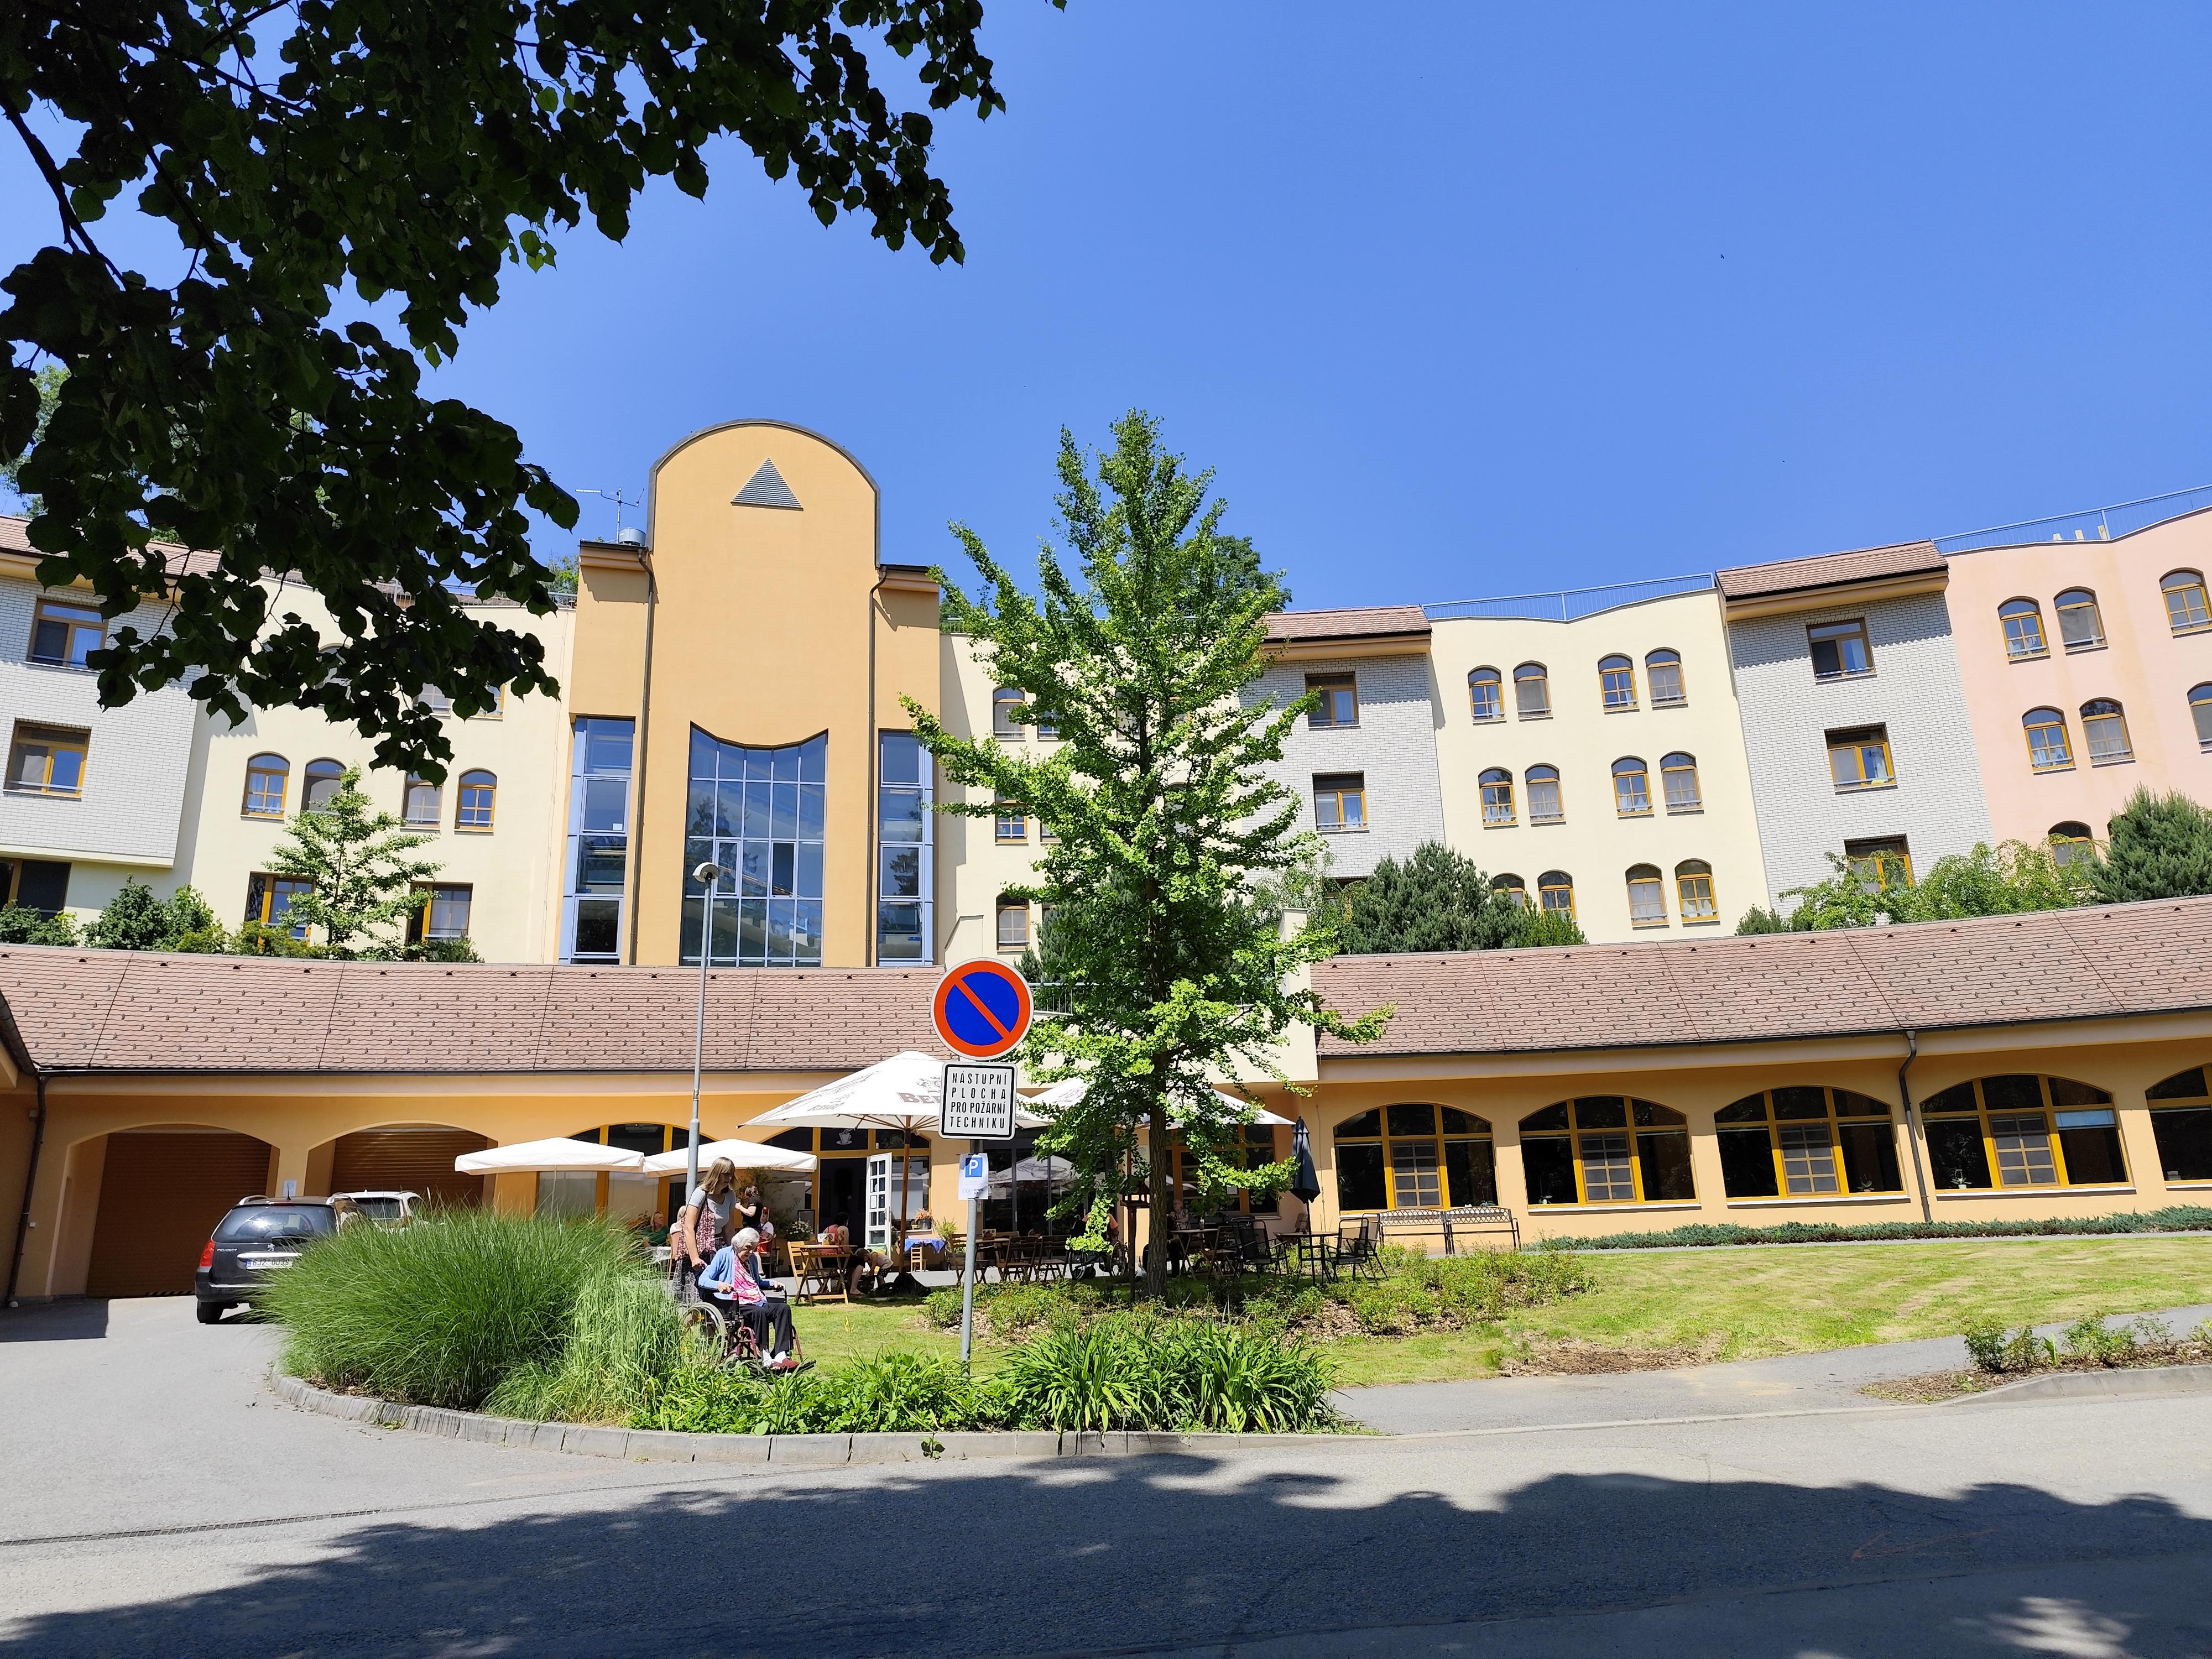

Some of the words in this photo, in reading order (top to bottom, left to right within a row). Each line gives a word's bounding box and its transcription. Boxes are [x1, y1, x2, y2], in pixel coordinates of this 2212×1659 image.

[952, 1071, 1007, 1085] NÁSTUPNÍ
[952, 1087, 1005, 1099] PLOCHA
[951, 1102, 967, 1113] PRO
[970, 1100, 1006, 1114] POŽÁRNÍ
[950, 1116, 1005, 1129] TECHNIKU
[969, 1159, 979, 1176] P
